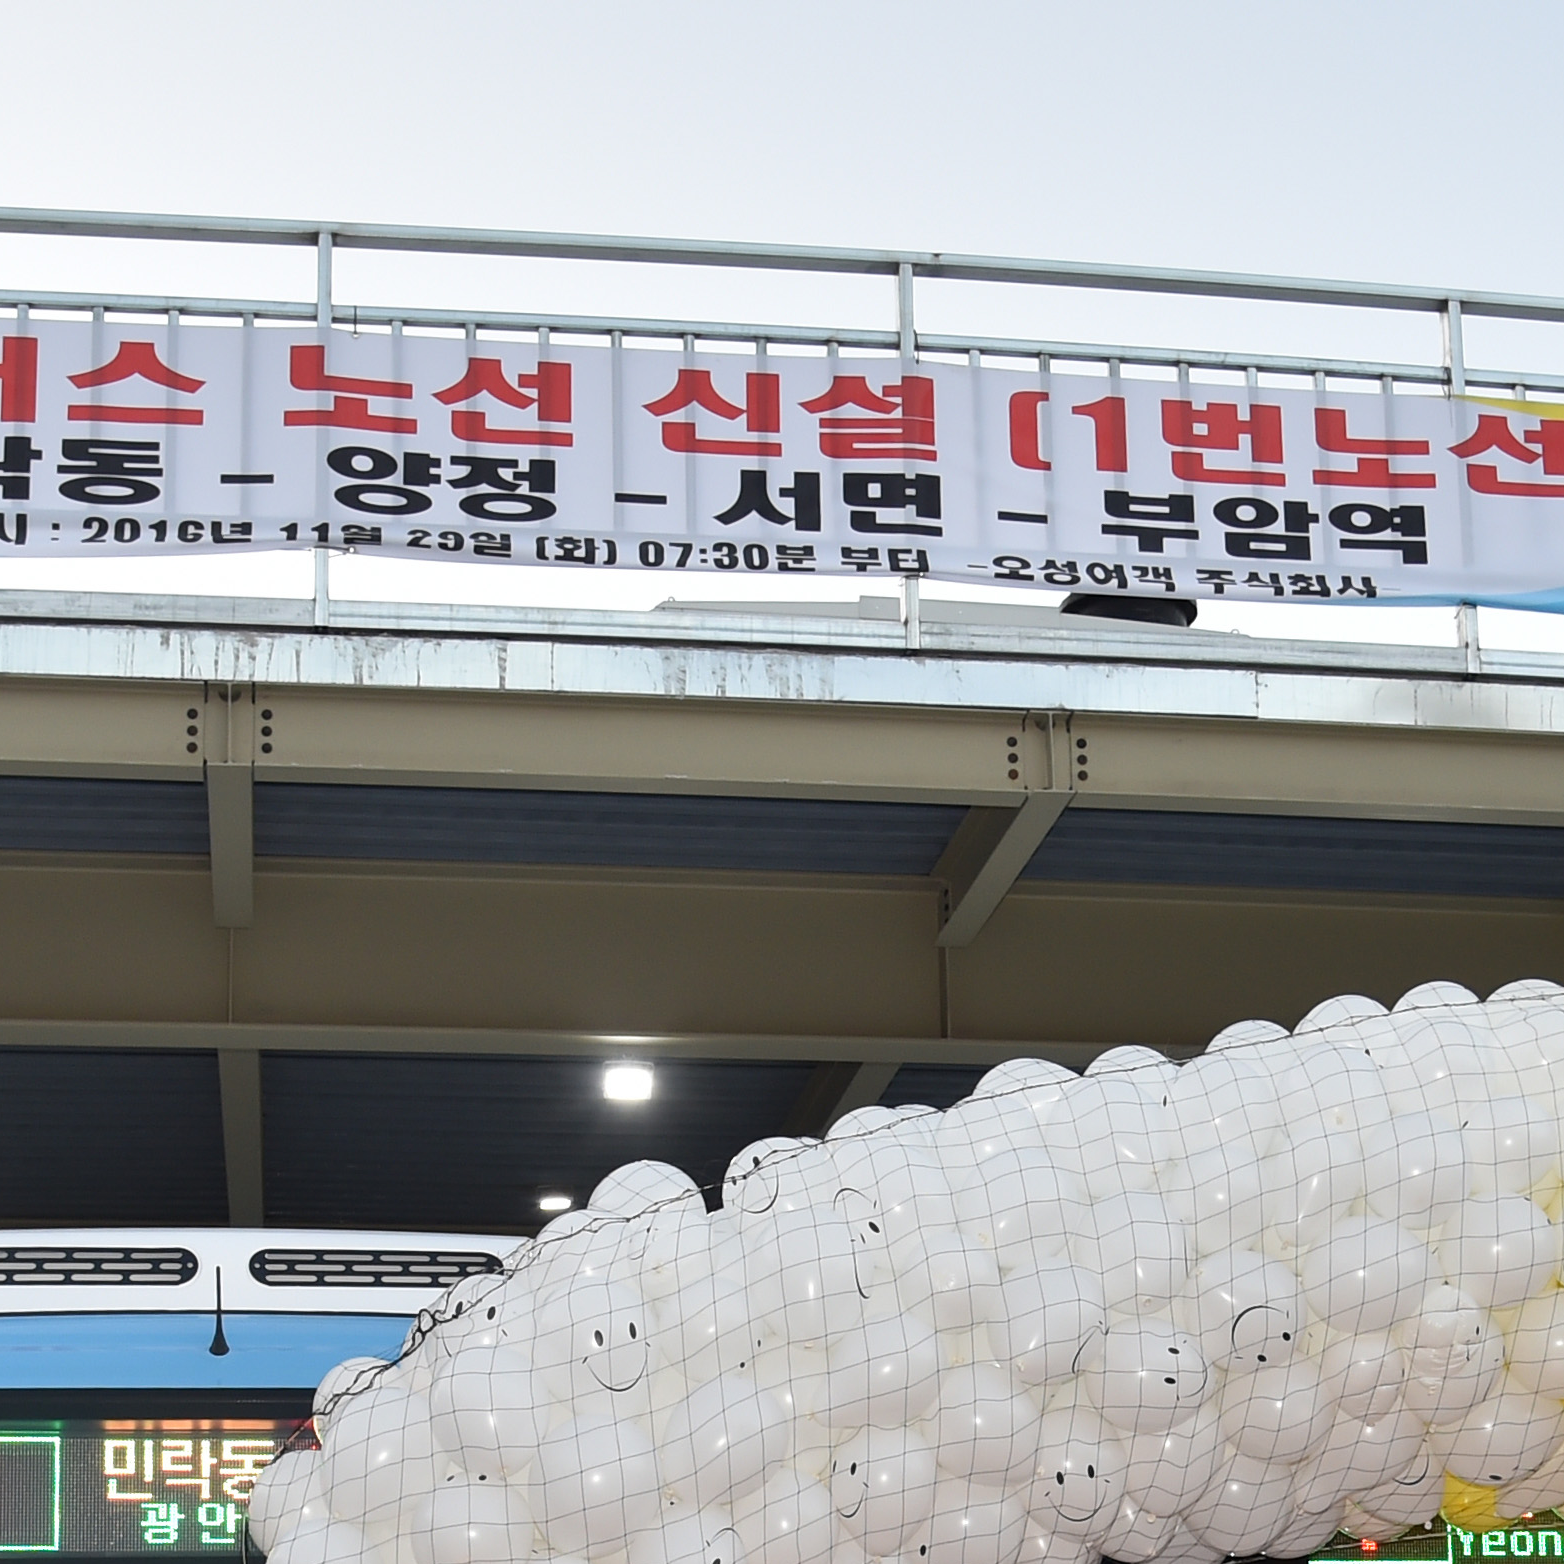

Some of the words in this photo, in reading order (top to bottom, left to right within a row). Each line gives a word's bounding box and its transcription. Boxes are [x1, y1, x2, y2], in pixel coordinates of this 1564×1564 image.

[283, 344, 574, 448] 노선
[642, 368, 938, 462] 신설
[81, 514, 254, 545] 2016년
[406, 528, 513, 560] 29일
[535, 534, 619, 567] (화)
[637, 540, 818, 574] 07:30분
[840, 545, 931, 574] 부터
[326, 444, 558, 522] 양정
[712, 468, 943, 538] 서면
[1100, 487, 1429, 566] 부암역
